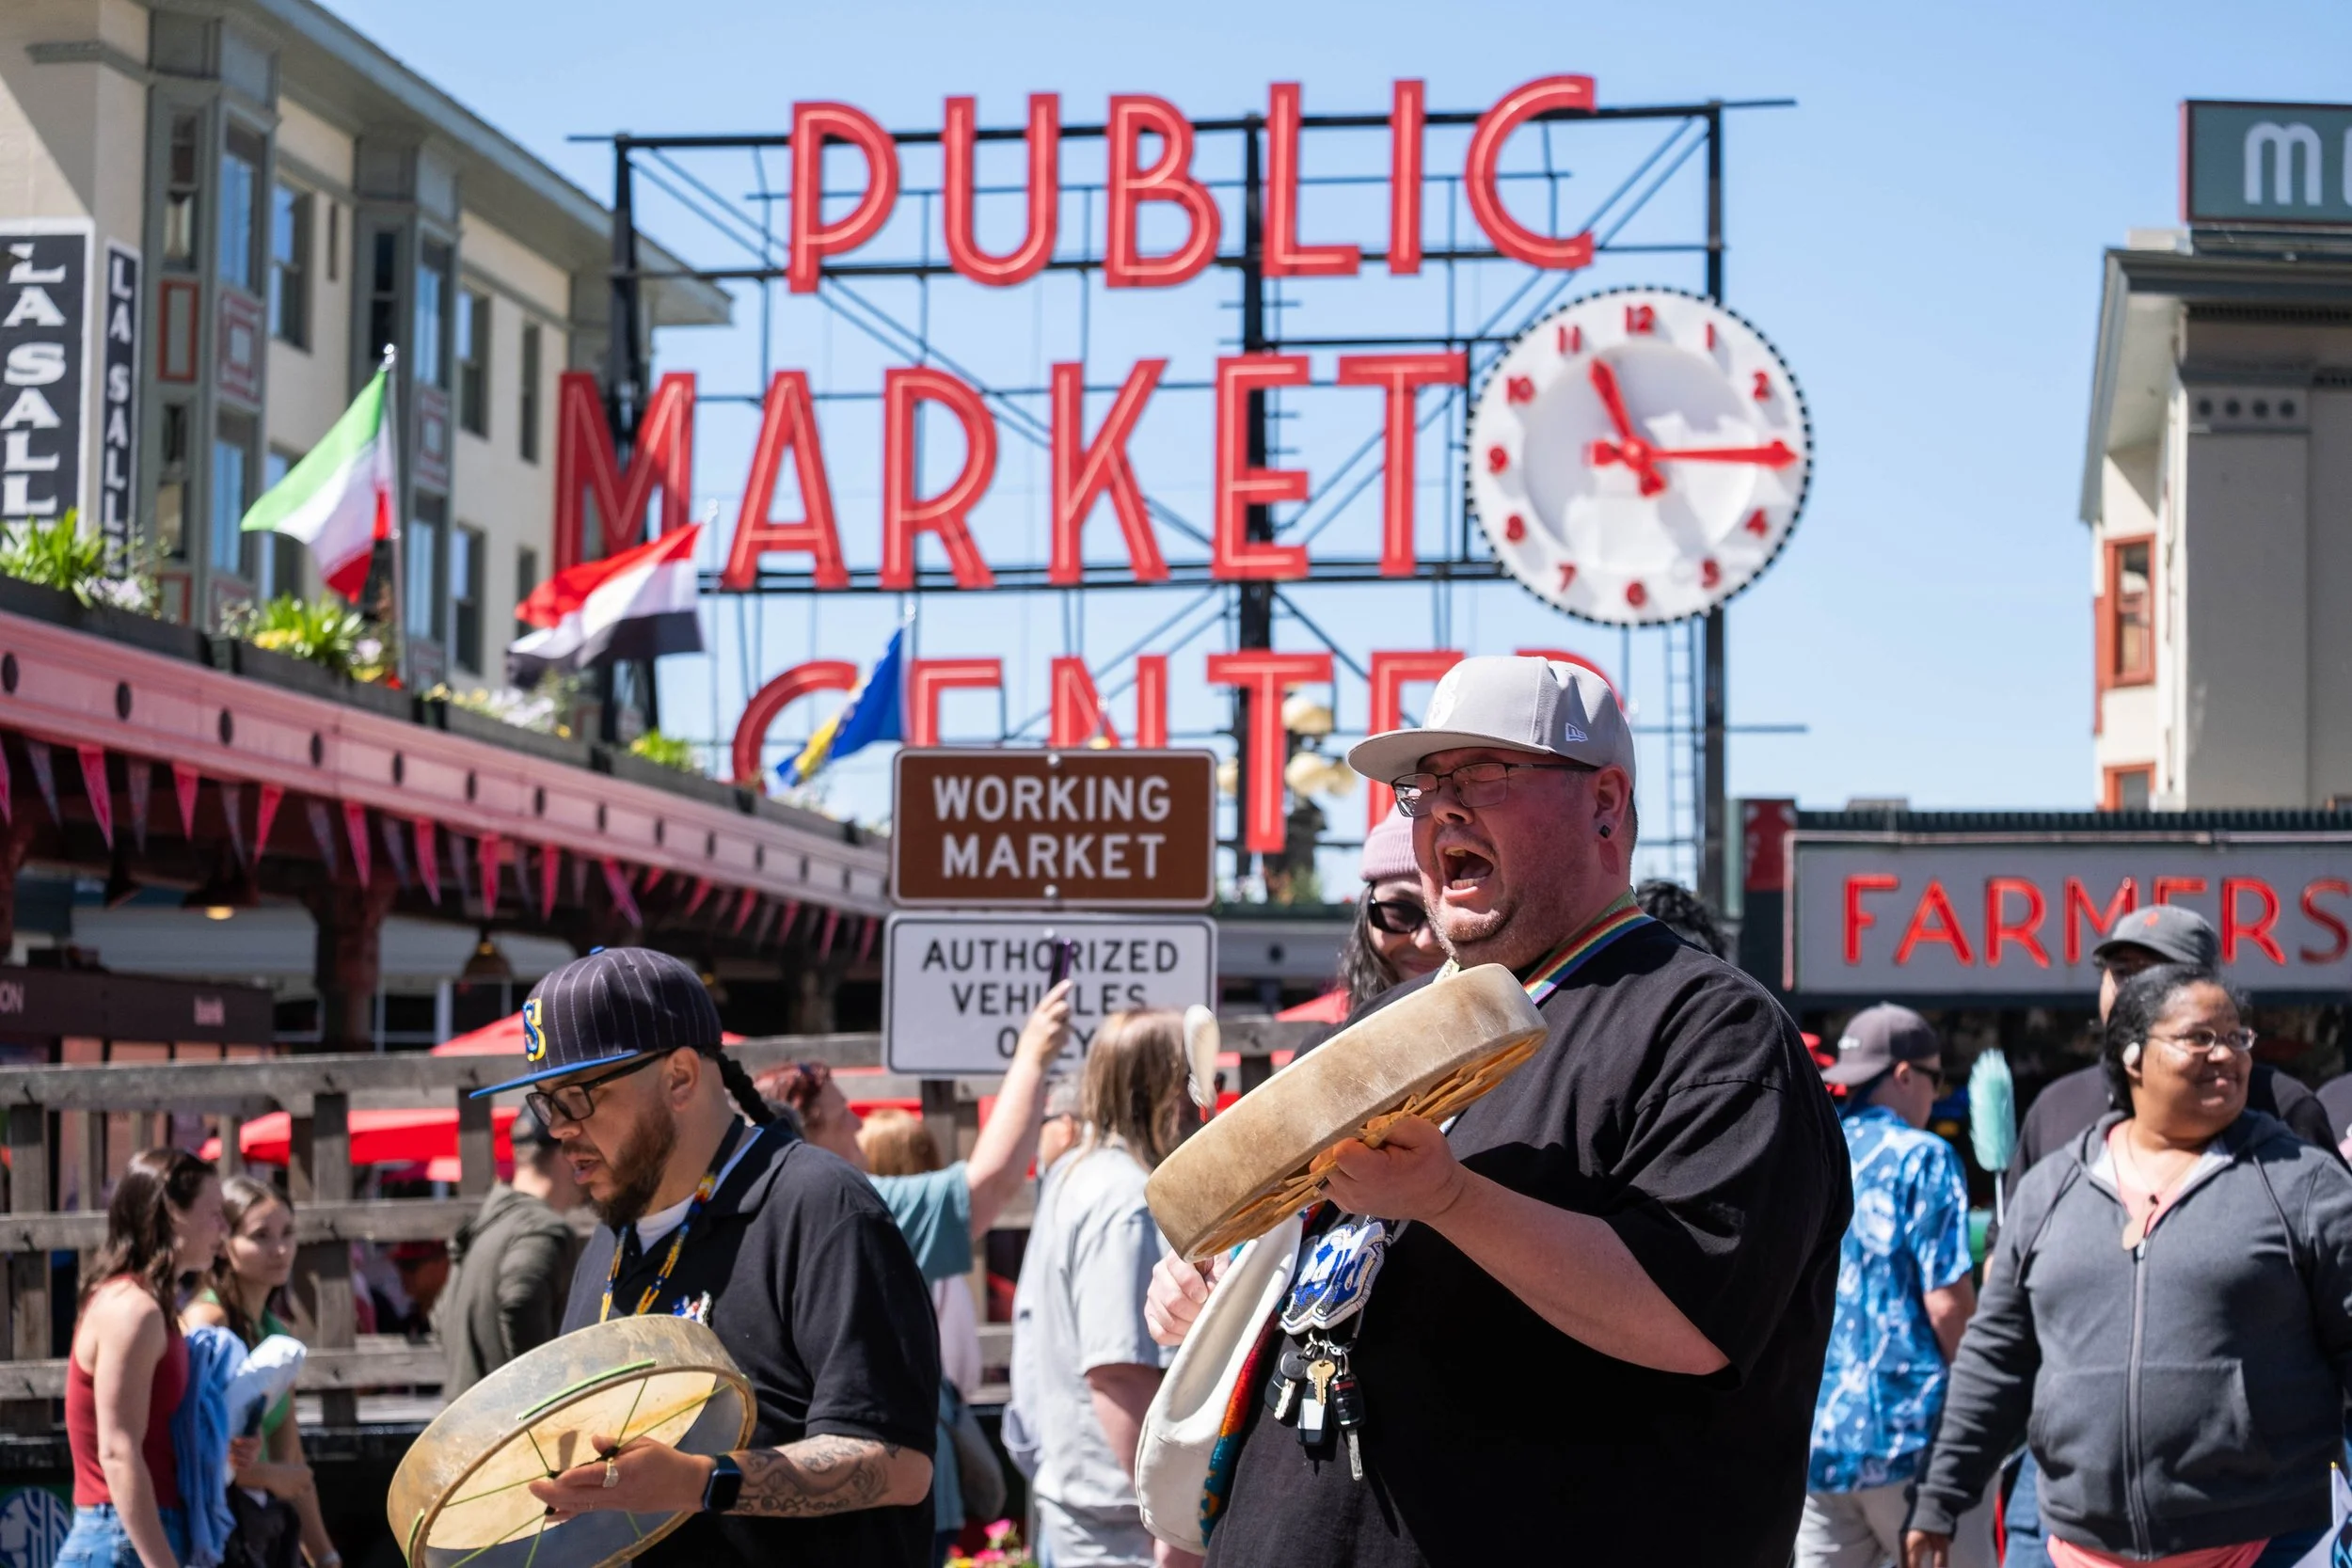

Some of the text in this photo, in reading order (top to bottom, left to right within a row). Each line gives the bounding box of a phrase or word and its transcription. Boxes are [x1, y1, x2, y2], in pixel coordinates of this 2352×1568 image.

[785, 75, 1595, 293] PUBLIC
[3, 242, 68, 327] LA
[109, 256, 134, 345] LA
[1625, 304, 1657, 336] 12
[1558, 326, 1582, 354] 11
[1705, 323, 1717, 351] 1
[1506, 376, 1535, 404] 10
[1753, 371, 1771, 402] 2
[555, 352, 1468, 590] MARKET
[1488, 445, 1509, 475] 9
[1505, 514, 1527, 543] 8
[1746, 508, 1770, 539] 4
[1557, 563, 1578, 594] 7
[1702, 559, 1723, 589] 5
[1626, 580, 1647, 609] 6
[932, 775, 1171, 822] WORKING
[942, 833, 1167, 879] MARKET
[951, 983, 1147, 1016] VEHILES
[998, 1026, 1097, 1060] OY
